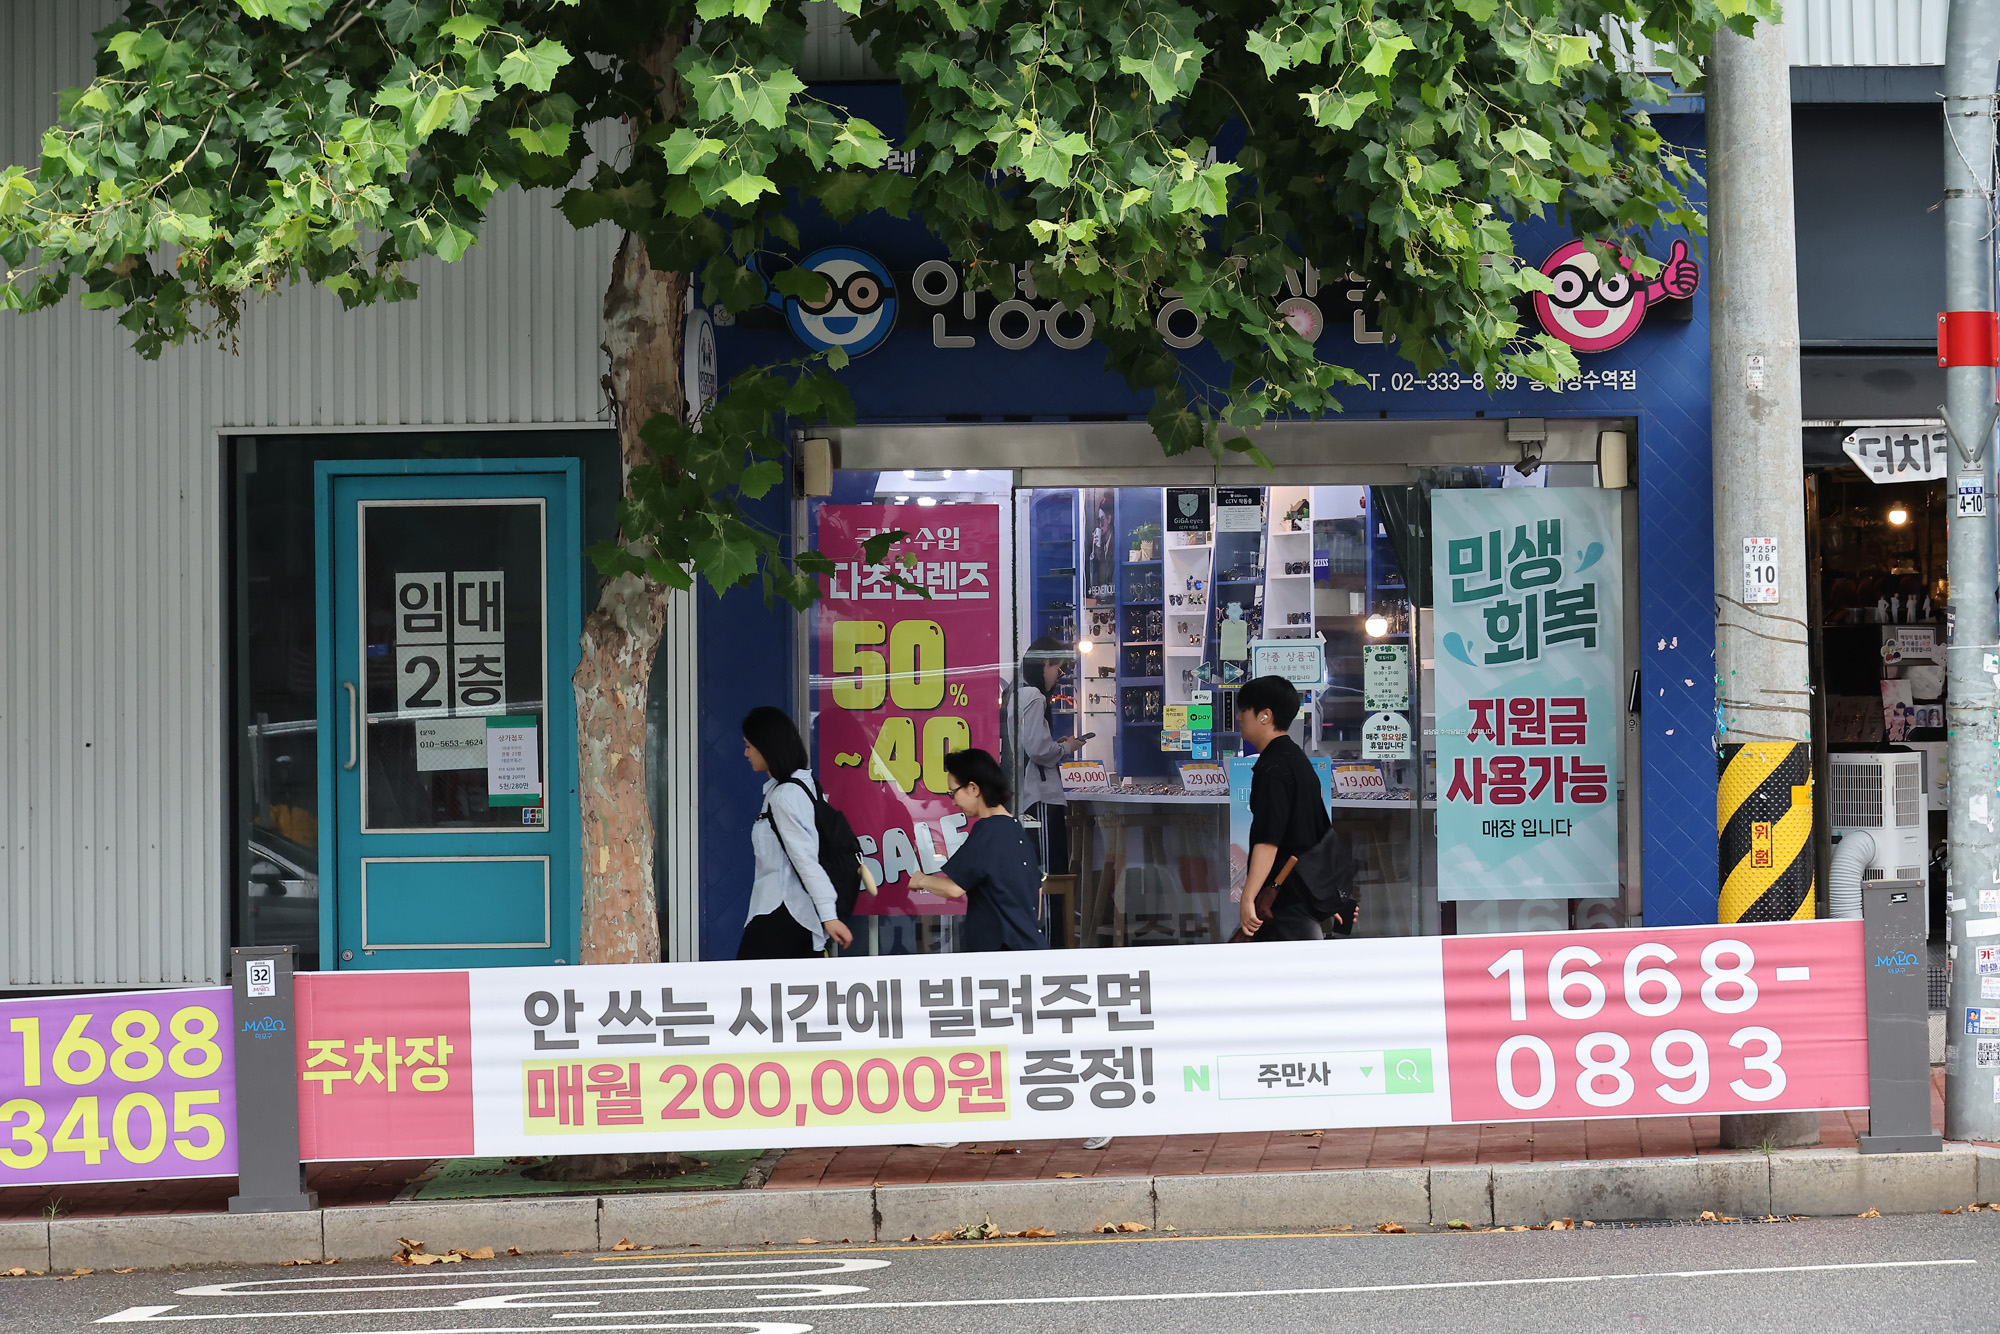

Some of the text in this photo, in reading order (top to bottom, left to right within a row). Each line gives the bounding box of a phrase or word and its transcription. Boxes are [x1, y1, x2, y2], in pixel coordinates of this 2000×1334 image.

[1391, 372, 1518, 391] 02-333-899
[1960, 495, 1983, 512] 4-10
[1449, 519, 1562, 604] 민생
[1754, 565, 1775, 584] 10
[399, 581, 501, 633] 임대
[1483, 583, 1598, 665] 회복
[1261, 651, 1316, 662] 각종 상품권
[405, 654, 503, 709] 2층
[1381, 733, 1408, 741] 일요일은
[1467, 698, 1588, 746] 지원금
[420, 739, 484, 748] 010-5653-4624
[1370, 742, 1404, 750] 휴일입니다
[1446, 756, 1608, 805] 사용가능
[1482, 818, 1573, 838] 매장 입니다
[1755, 824, 1770, 866] 위험
[253, 969, 268, 982] 32
[1874, 950, 1919, 967] MAPO
[241, 1016, 287, 1032] MAPO
[524, 970, 1155, 1050] 안 쓰는 시간에 빌려주면
[10, 1006, 223, 1087] 1688
[302, 1035, 455, 1095] 주차장
[527, 1046, 1156, 1127] 매월 200,000원 증정!
[1257, 1061, 1331, 1088] 주만사
[1495, 1026, 1788, 1111] 0893
[0, 1089, 226, 1169] 3405
